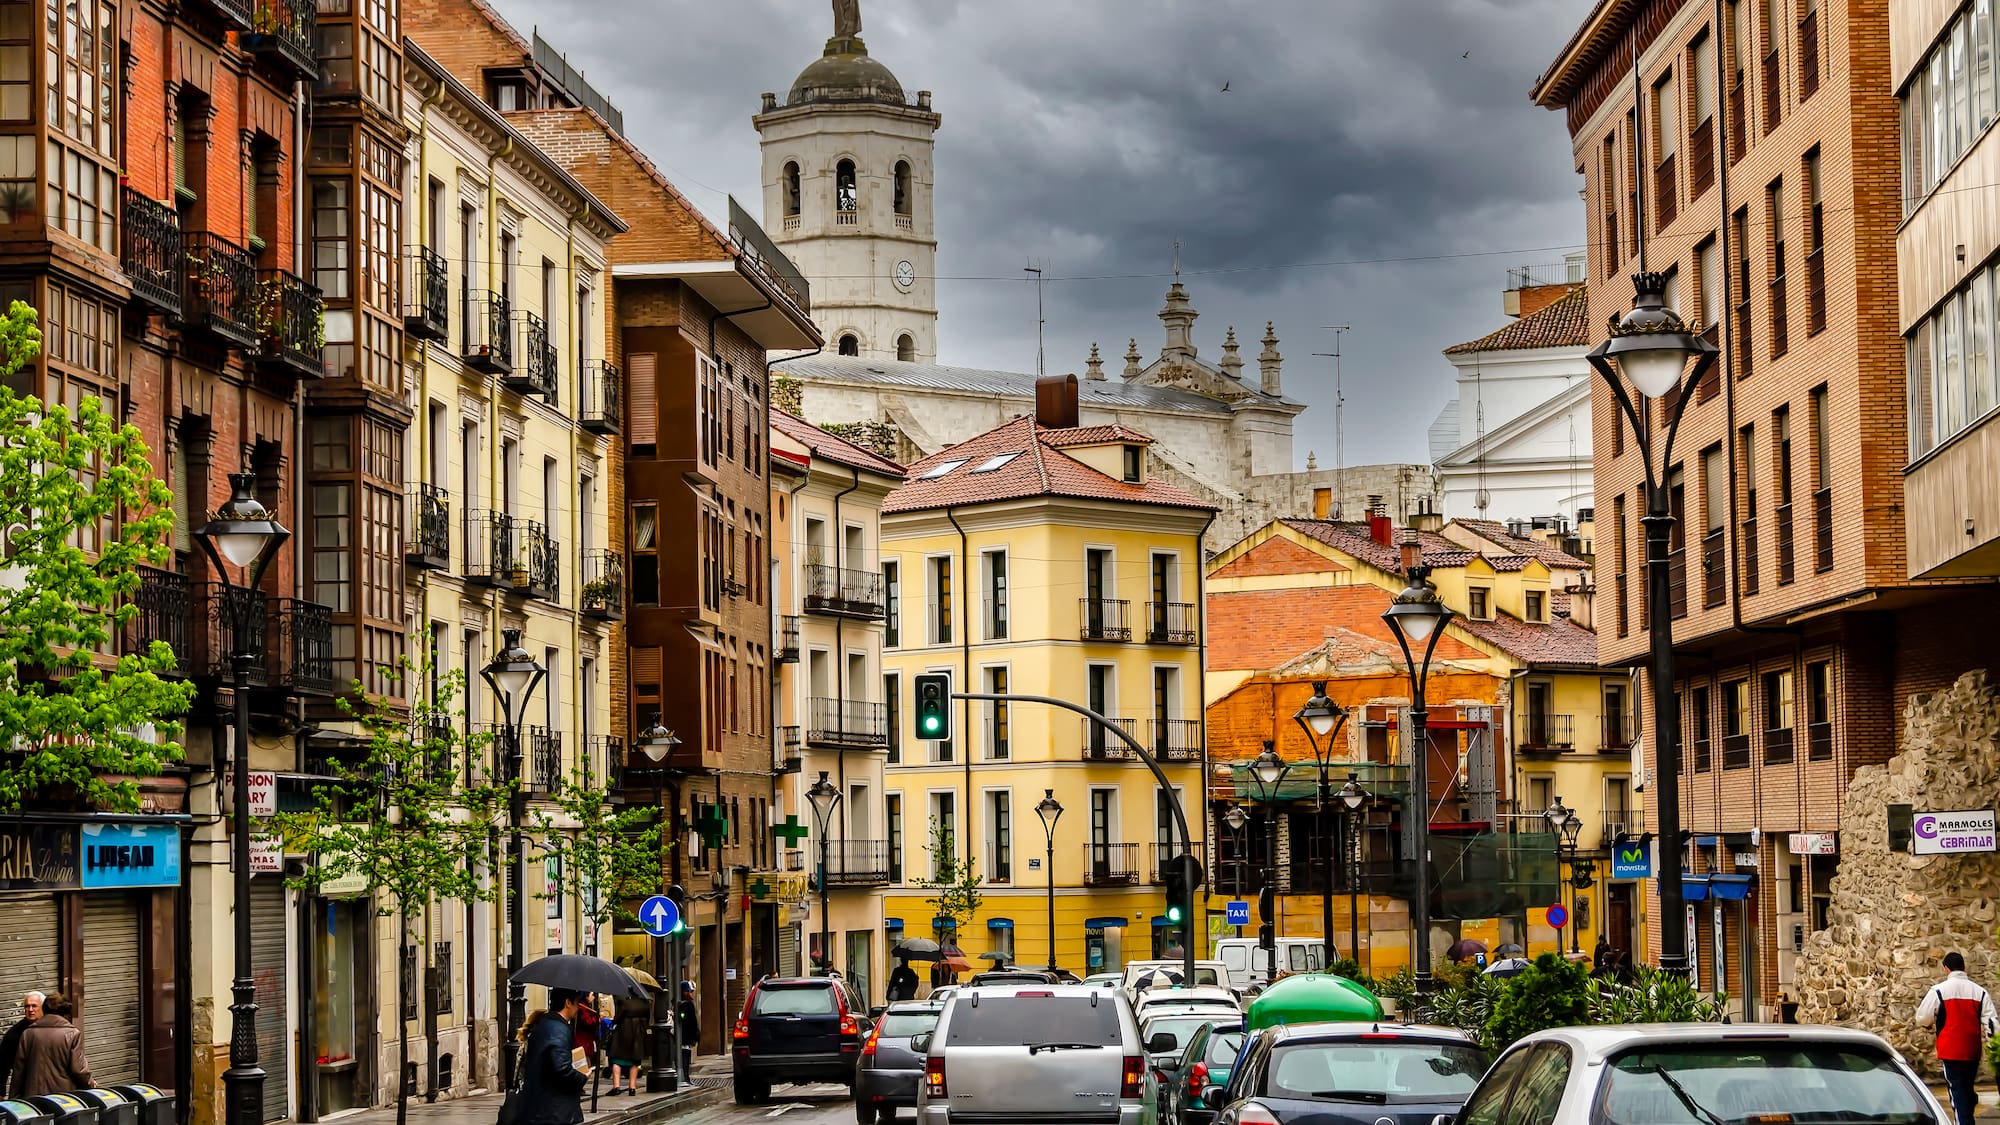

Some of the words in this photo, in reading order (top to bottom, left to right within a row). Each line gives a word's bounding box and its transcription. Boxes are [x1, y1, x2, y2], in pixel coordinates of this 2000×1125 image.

[225, 775, 273, 787] PSION
[1939, 819, 1993, 829] MARMOLES
[87, 845, 154, 867] LUISAN
[1616, 864, 1648, 872] movistar
[1228, 909, 1248, 917] TAXI
[1477, 955, 1484, 964] P
